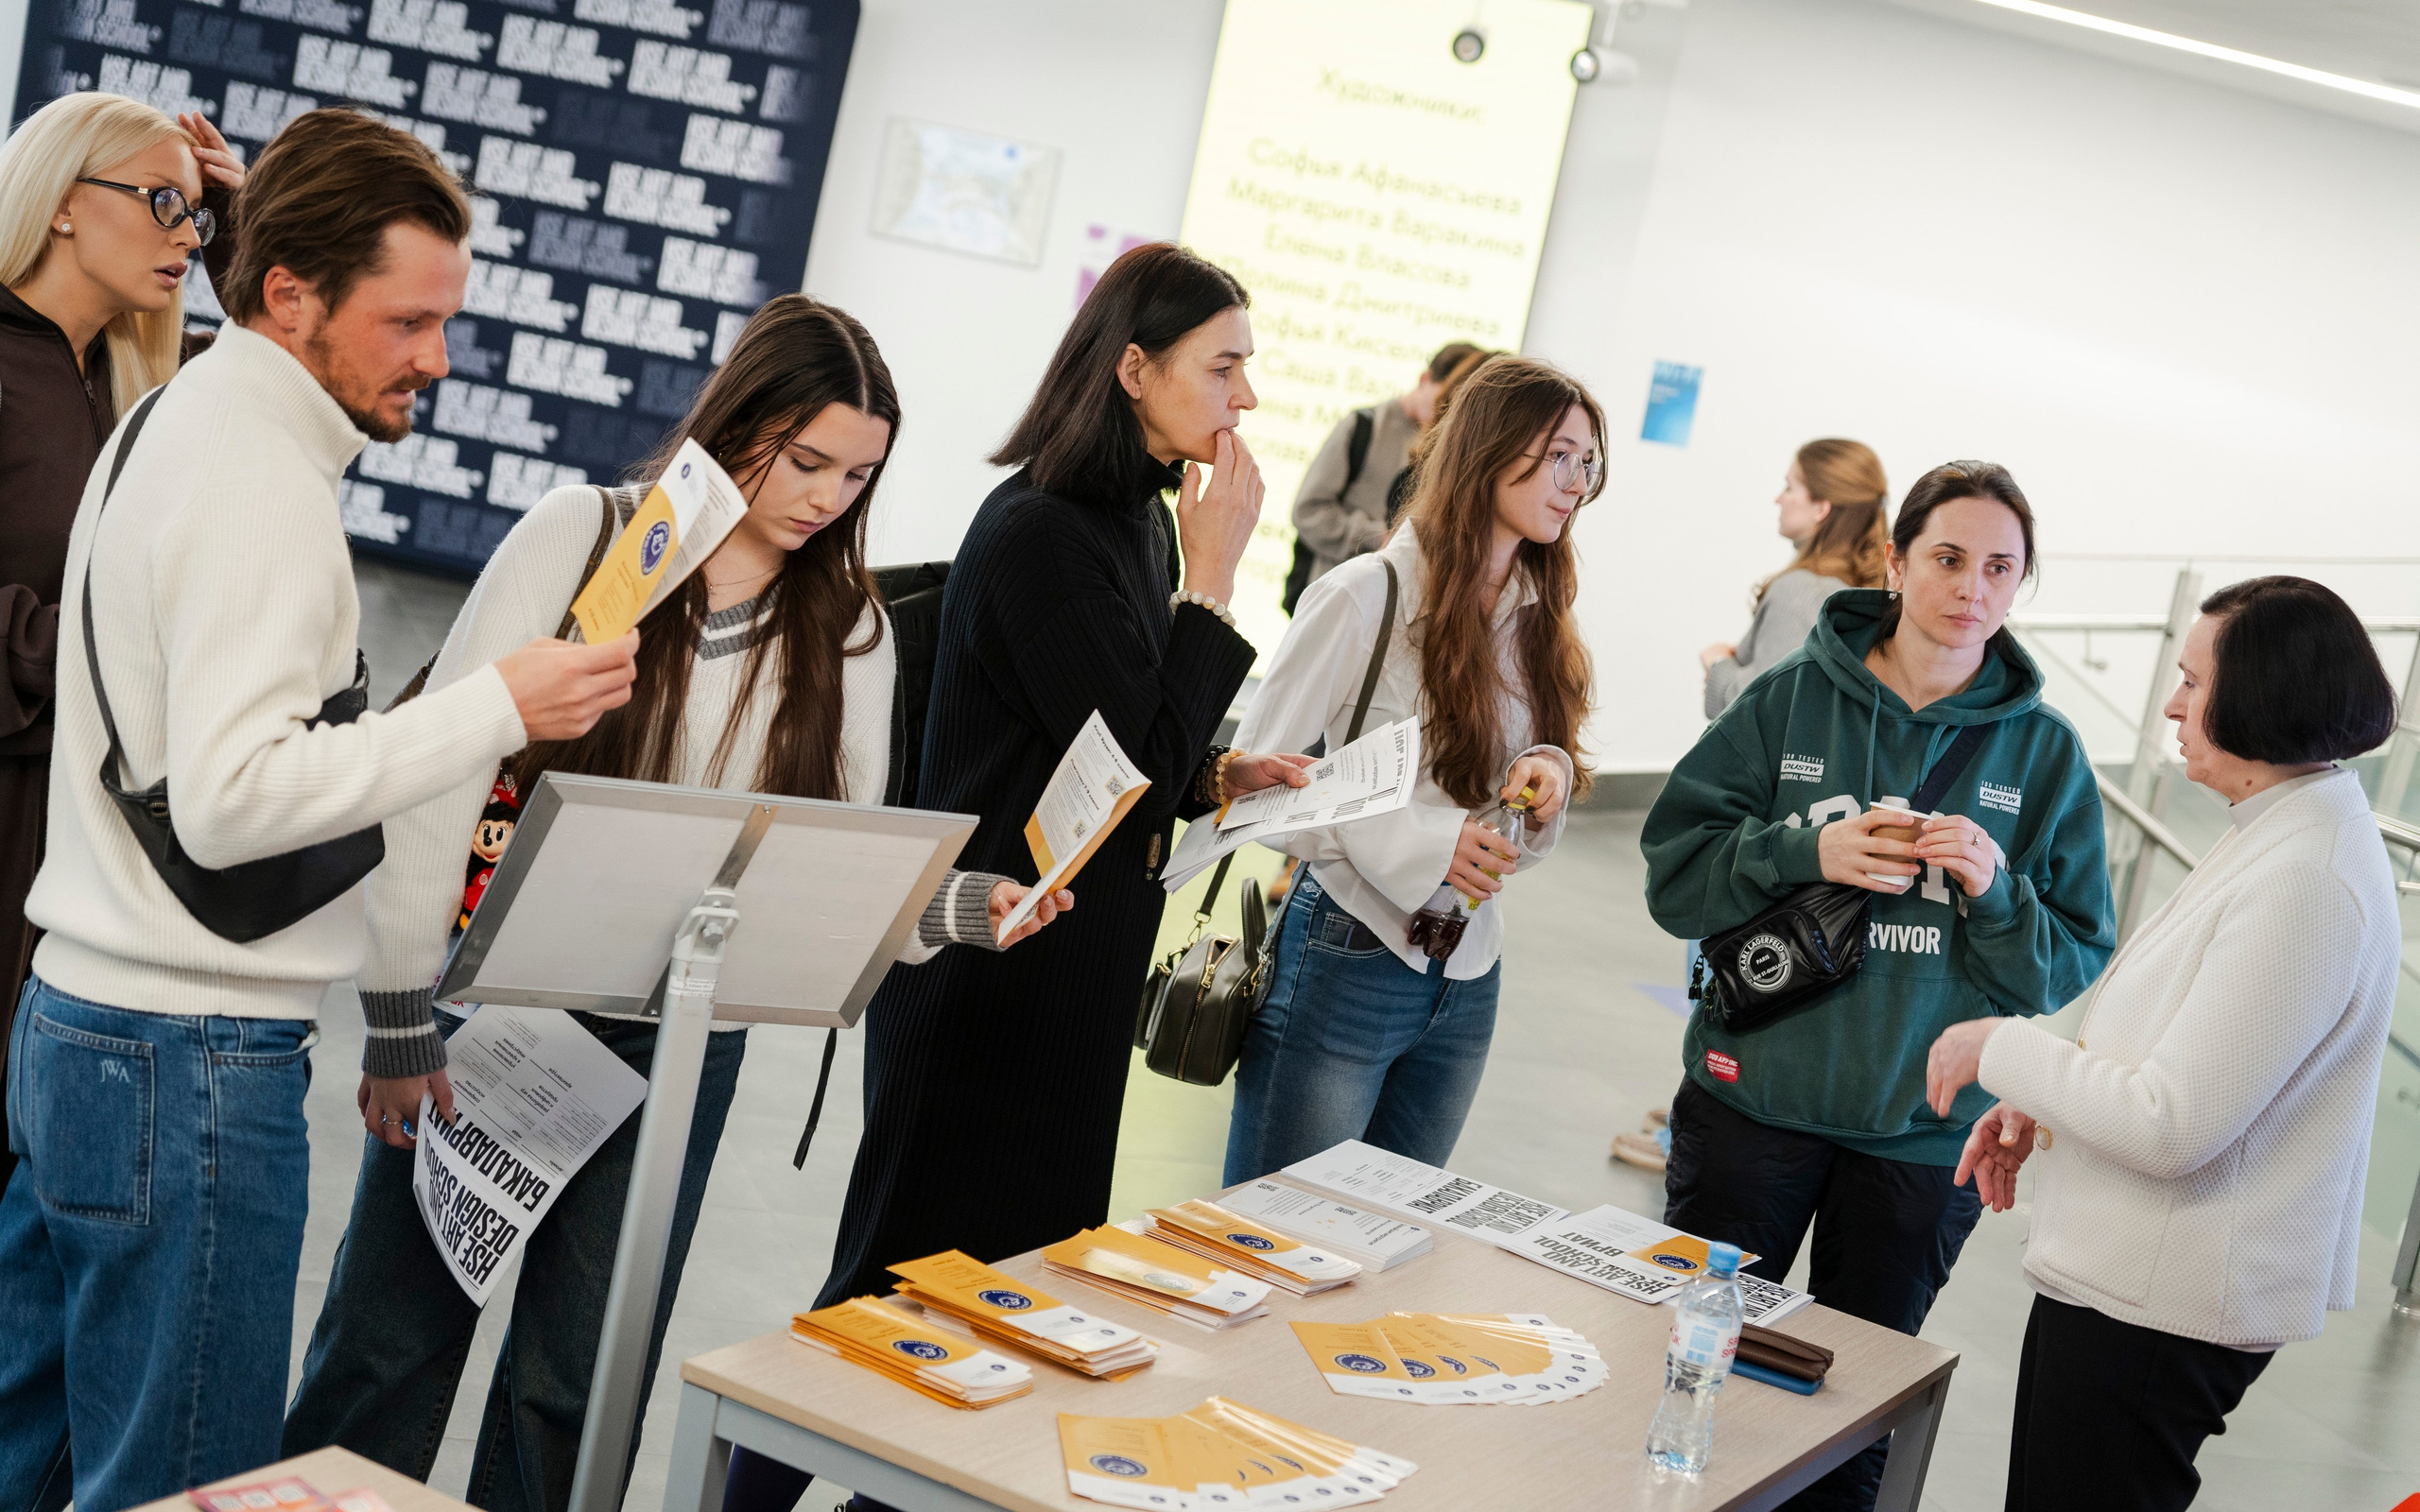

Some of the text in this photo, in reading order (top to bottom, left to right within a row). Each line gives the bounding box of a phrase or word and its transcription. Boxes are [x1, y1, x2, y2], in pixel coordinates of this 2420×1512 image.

[1248, 136, 1523, 215] Софья Афанасьева
[1227, 178, 1528, 259] Маргарита Варакина
[1264, 223, 1472, 289] Елена Власова
[1334, 281, 1500, 337] Дмитриева
[1784, 764, 1820, 772] DUSTW
[1799, 755, 1824, 764] TESTED
[1983, 791, 2017, 803] DUSTW
[1996, 784, 2021, 794] TESTED
[1979, 799, 1998, 810] NATURAL
[1740, 936, 1785, 971] KARL LAGERFELD
[1755, 954, 1771, 965] PARIS
[463, 1079, 486, 1098] искусство
[547, 1067, 573, 1090] архитектура
[453, 1079, 481, 1104] современное
[519, 1087, 549, 1113] разработка игр
[529, 1086, 551, 1107] цифровых
[537, 1084, 559, 1103] продуктов
[424, 1127, 459, 1206] SCHOOL
[1406, 1177, 1483, 1214] БАКАЛАВРИАТ
[1476, 1191, 1527, 1216] DESIGN
[449, 1183, 519, 1256] DESIGN
[1501, 1209, 1538, 1227] ART
[1516, 1199, 1554, 1218] HSE
[427, 1178, 499, 1285] HSE ART AND
[1531, 1234, 1603, 1264] SCHOOL
[1540, 1250, 1661, 1296] HSE ART AND
[1745, 1291, 1781, 1309] ART
[1763, 1284, 1796, 1299] HSE
